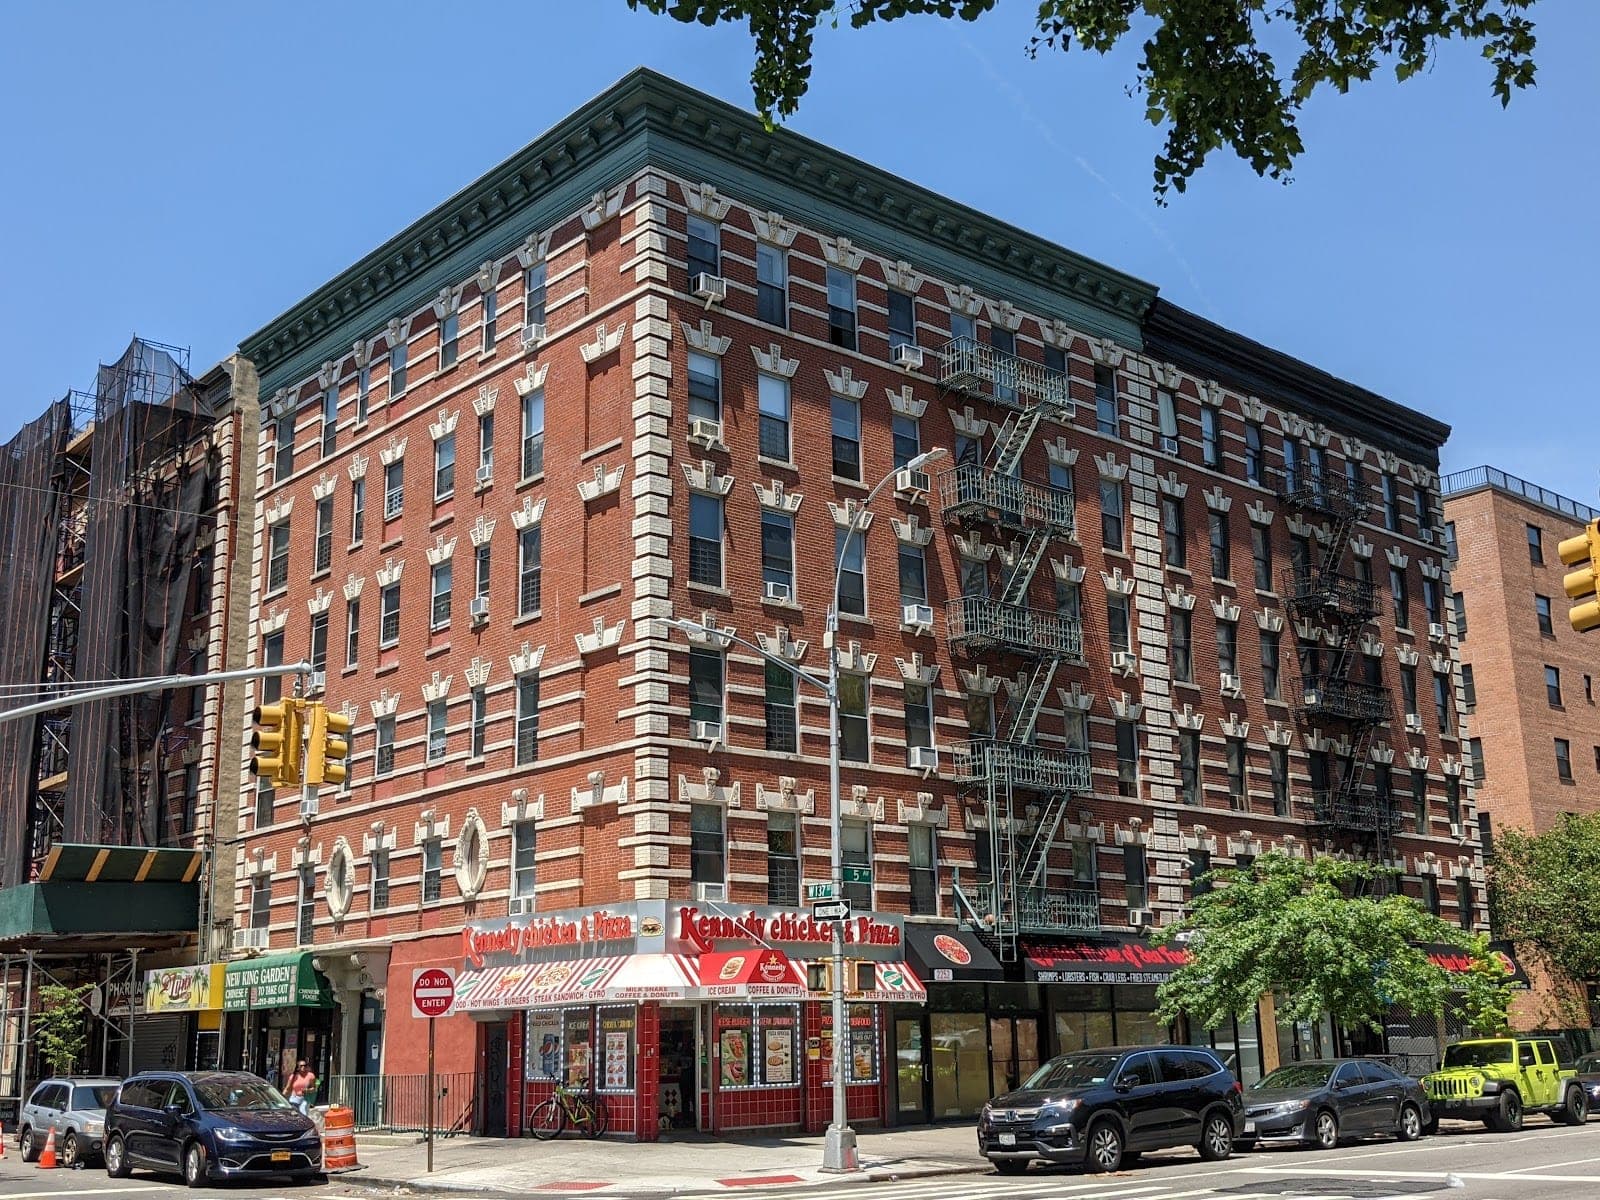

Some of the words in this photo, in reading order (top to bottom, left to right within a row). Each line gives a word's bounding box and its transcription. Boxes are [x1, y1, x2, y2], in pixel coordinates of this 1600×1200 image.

[853, 870, 860, 881] 5
[808, 885, 814, 897] W
[815, 884, 826, 897] 137
[817, 907, 830, 915] ONE
[680, 907, 767, 954] Kennedy
[844, 920, 854, 943] &
[857, 916, 900, 944] Pizza
[462, 922, 522, 967] Kennedy
[523, 917, 578, 948] chicken
[580, 915, 590, 942] &
[593, 911, 632, 940] Pizza
[760, 962, 786, 975] Kennedy
[225, 972, 241, 988] NEW
[242, 970, 259, 985] KING
[260, 966, 291, 984] GARDEN
[434, 977, 448, 985] NOT
[1037, 971, 1058, 982] SHRIMPS
[1062, 972, 1086, 982] LOBSTERS
[1088, 972, 1100, 982] FISH
[1102, 972, 1115, 982] CRAB
[225, 988, 245, 998] CHINESE
[258, 986, 265, 996] TO
[265, 985, 277, 995] TAKE
[277, 984, 289, 994] OUT
[707, 987, 717, 995] ICE
[718, 986, 737, 995] CREAM
[748, 986, 770, 995] COFFEE
[771, 986, 775, 994] &
[777, 985, 800, 995] DONUTS
[422, 998, 446, 1008] ENTER
[470, 1000, 481, 1008] HOT
[482, 998, 500, 1007] WINGS
[504, 996, 530, 1006] BURGERS
[534, 993, 552, 1003] STEAK
[554, 991, 583, 1002] SANDWICH
[588, 990, 606, 998] GYRO
